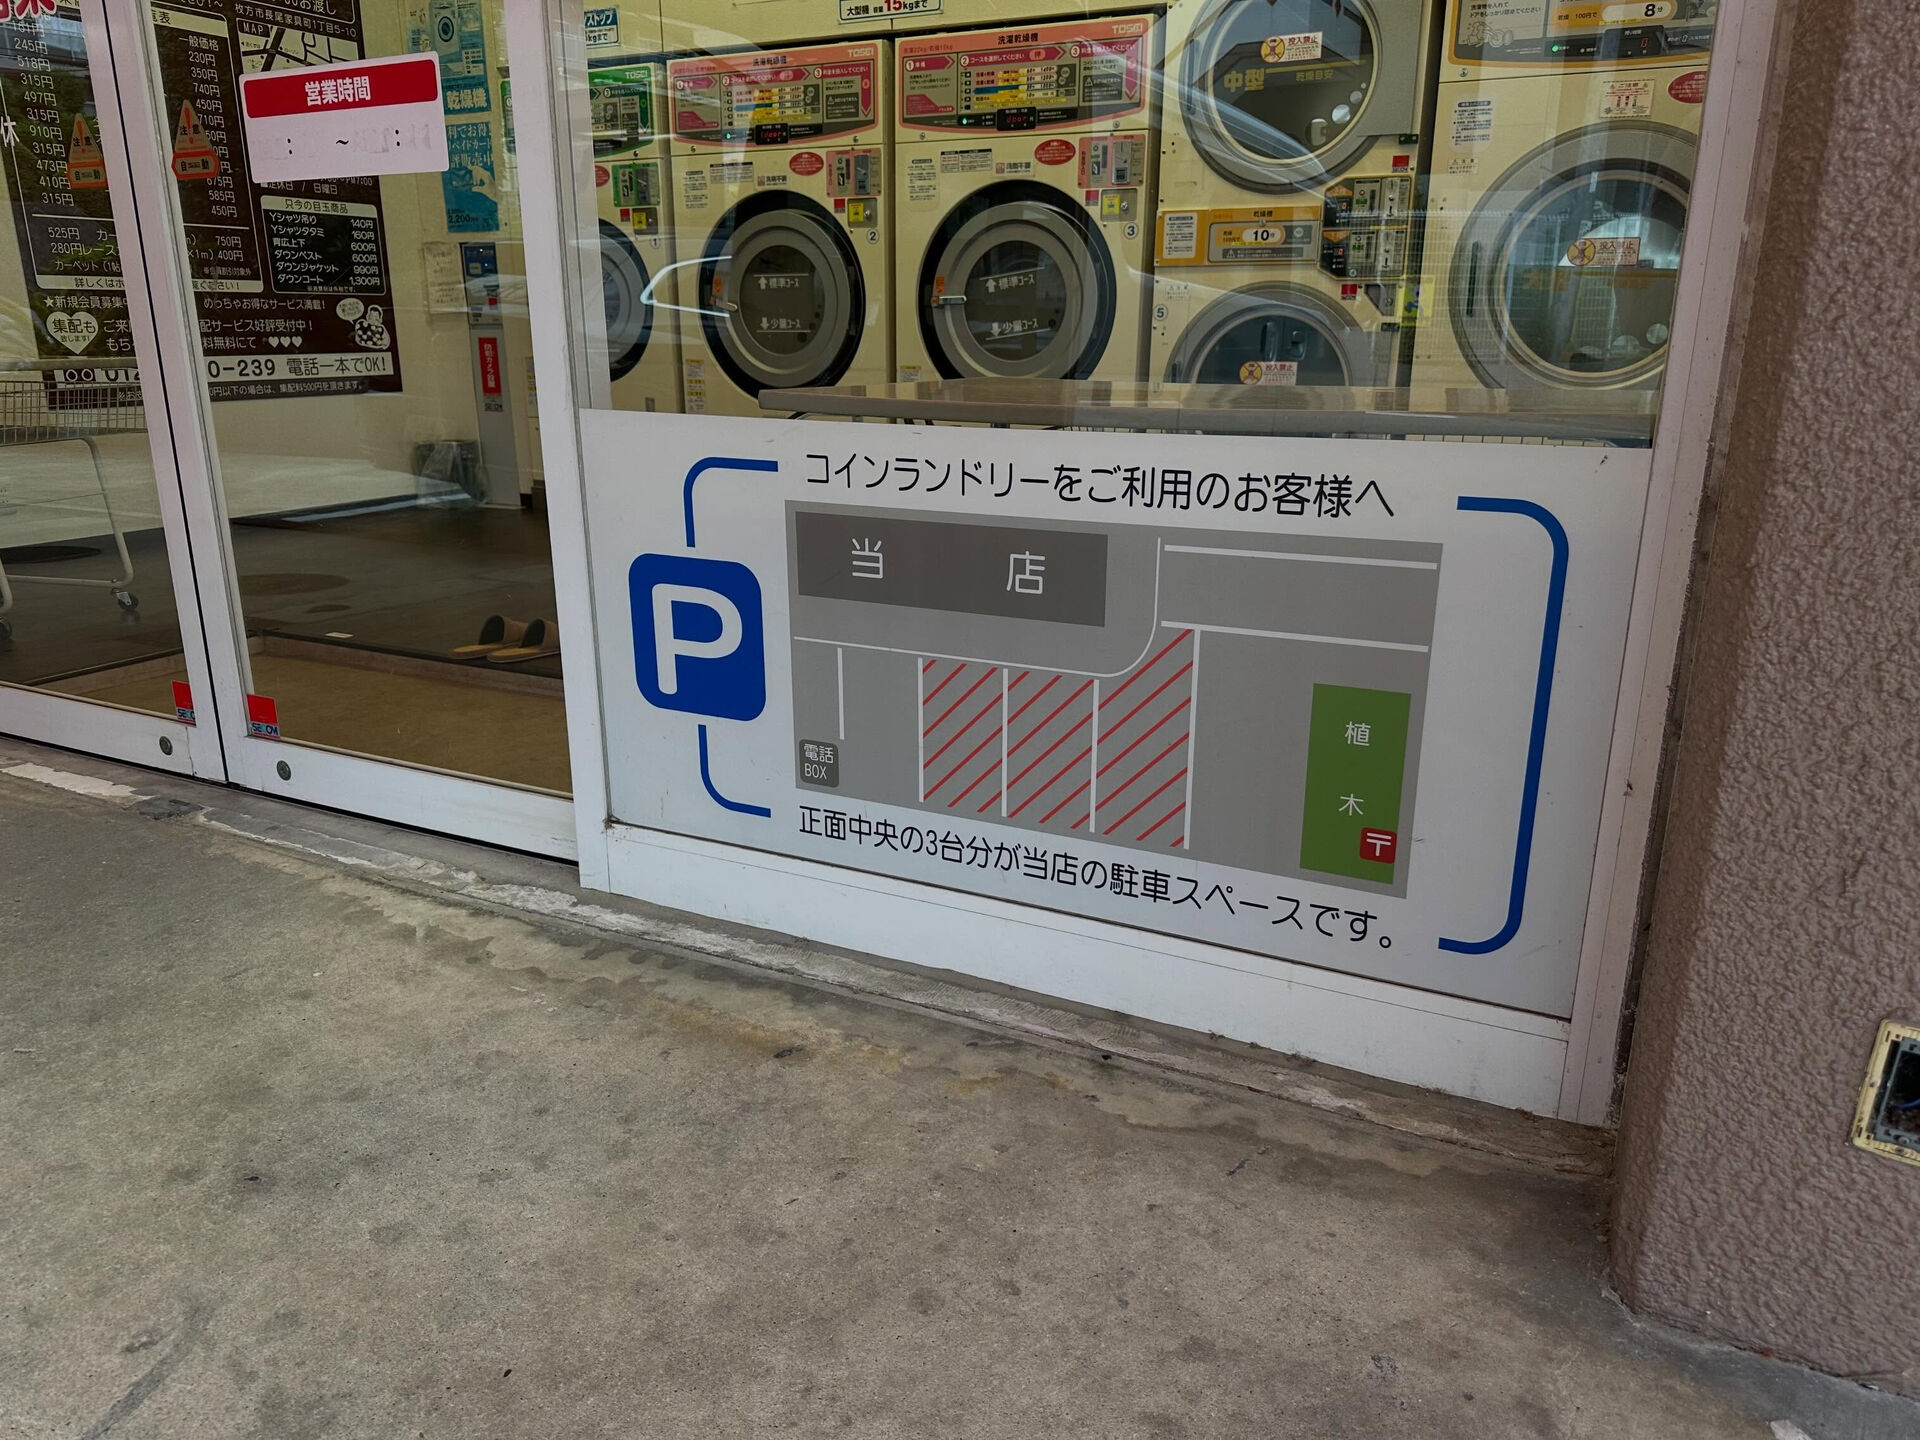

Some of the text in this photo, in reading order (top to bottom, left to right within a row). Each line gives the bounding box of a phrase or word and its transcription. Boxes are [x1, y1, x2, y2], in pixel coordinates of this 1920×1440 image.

[1644, 3, 1656, 17] 8
[243, 22, 264, 35] MAP
[14, 37, 48, 55] 245円
[179, 35, 219, 51] 一般価格
[17, 55, 51, 72] 518円
[189, 51, 216, 66] 230円
[20, 73, 54, 89] 315円
[191, 67, 218, 82] 350円
[1224, 68, 1265, 93] 中型
[193, 82, 220, 97] 740円
[305, 76, 371, 106] 営業時間
[24, 91, 57, 106] 497円
[196, 99, 223, 113] 450円
[26, 107, 60, 123] 315円
[198, 113, 225, 128] 710円
[29, 125, 63, 140] 910円
[32, 142, 66, 157] 315円
[36, 159, 68, 174] 473円
[39, 176, 72, 190] 410円
[313, 183, 338, 195] 日曜日
[42, 192, 75, 207] 315円
[208, 190, 236, 203] 585円
[211, 205, 238, 218] 450円
[285, 198, 348, 214] 只今の目玉商品
[269, 212, 374, 229] Yシャツ吊り 140円
[47, 226, 80, 240] 525円
[270, 224, 375, 241] Yシャツタタミ 160円
[1253, 229, 1270, 241] 10
[50, 242, 83, 255] 280円
[215, 235, 242, 248] 750円
[272, 237, 376, 252] 背広上下 600円
[218, 249, 244, 261] 400円
[274, 250, 378, 264] ダウンベスト 600円
[276, 261, 379, 275] ダウンジャケット 990円
[277, 273, 380, 286] ダウンコート 1,300円
[53, 318, 96, 334] 集配も
[208, 356, 386, 379] 0-239 電話一本でOK!
[806, 452, 1395, 518] コインランドリーをご利用のお客様へ
[851, 538, 1046, 594] 当 店
[651, 582, 743, 696] P
[252, 722, 278, 735] SECOM
[1344, 721, 1371, 747] 植
[803, 744, 834, 765] 電話
[804, 764, 828, 780] BOX
[1338, 793, 1365, 817] 木
[799, 805, 1392, 950] 正面中央の3台分が当店の駐車スペースです。
